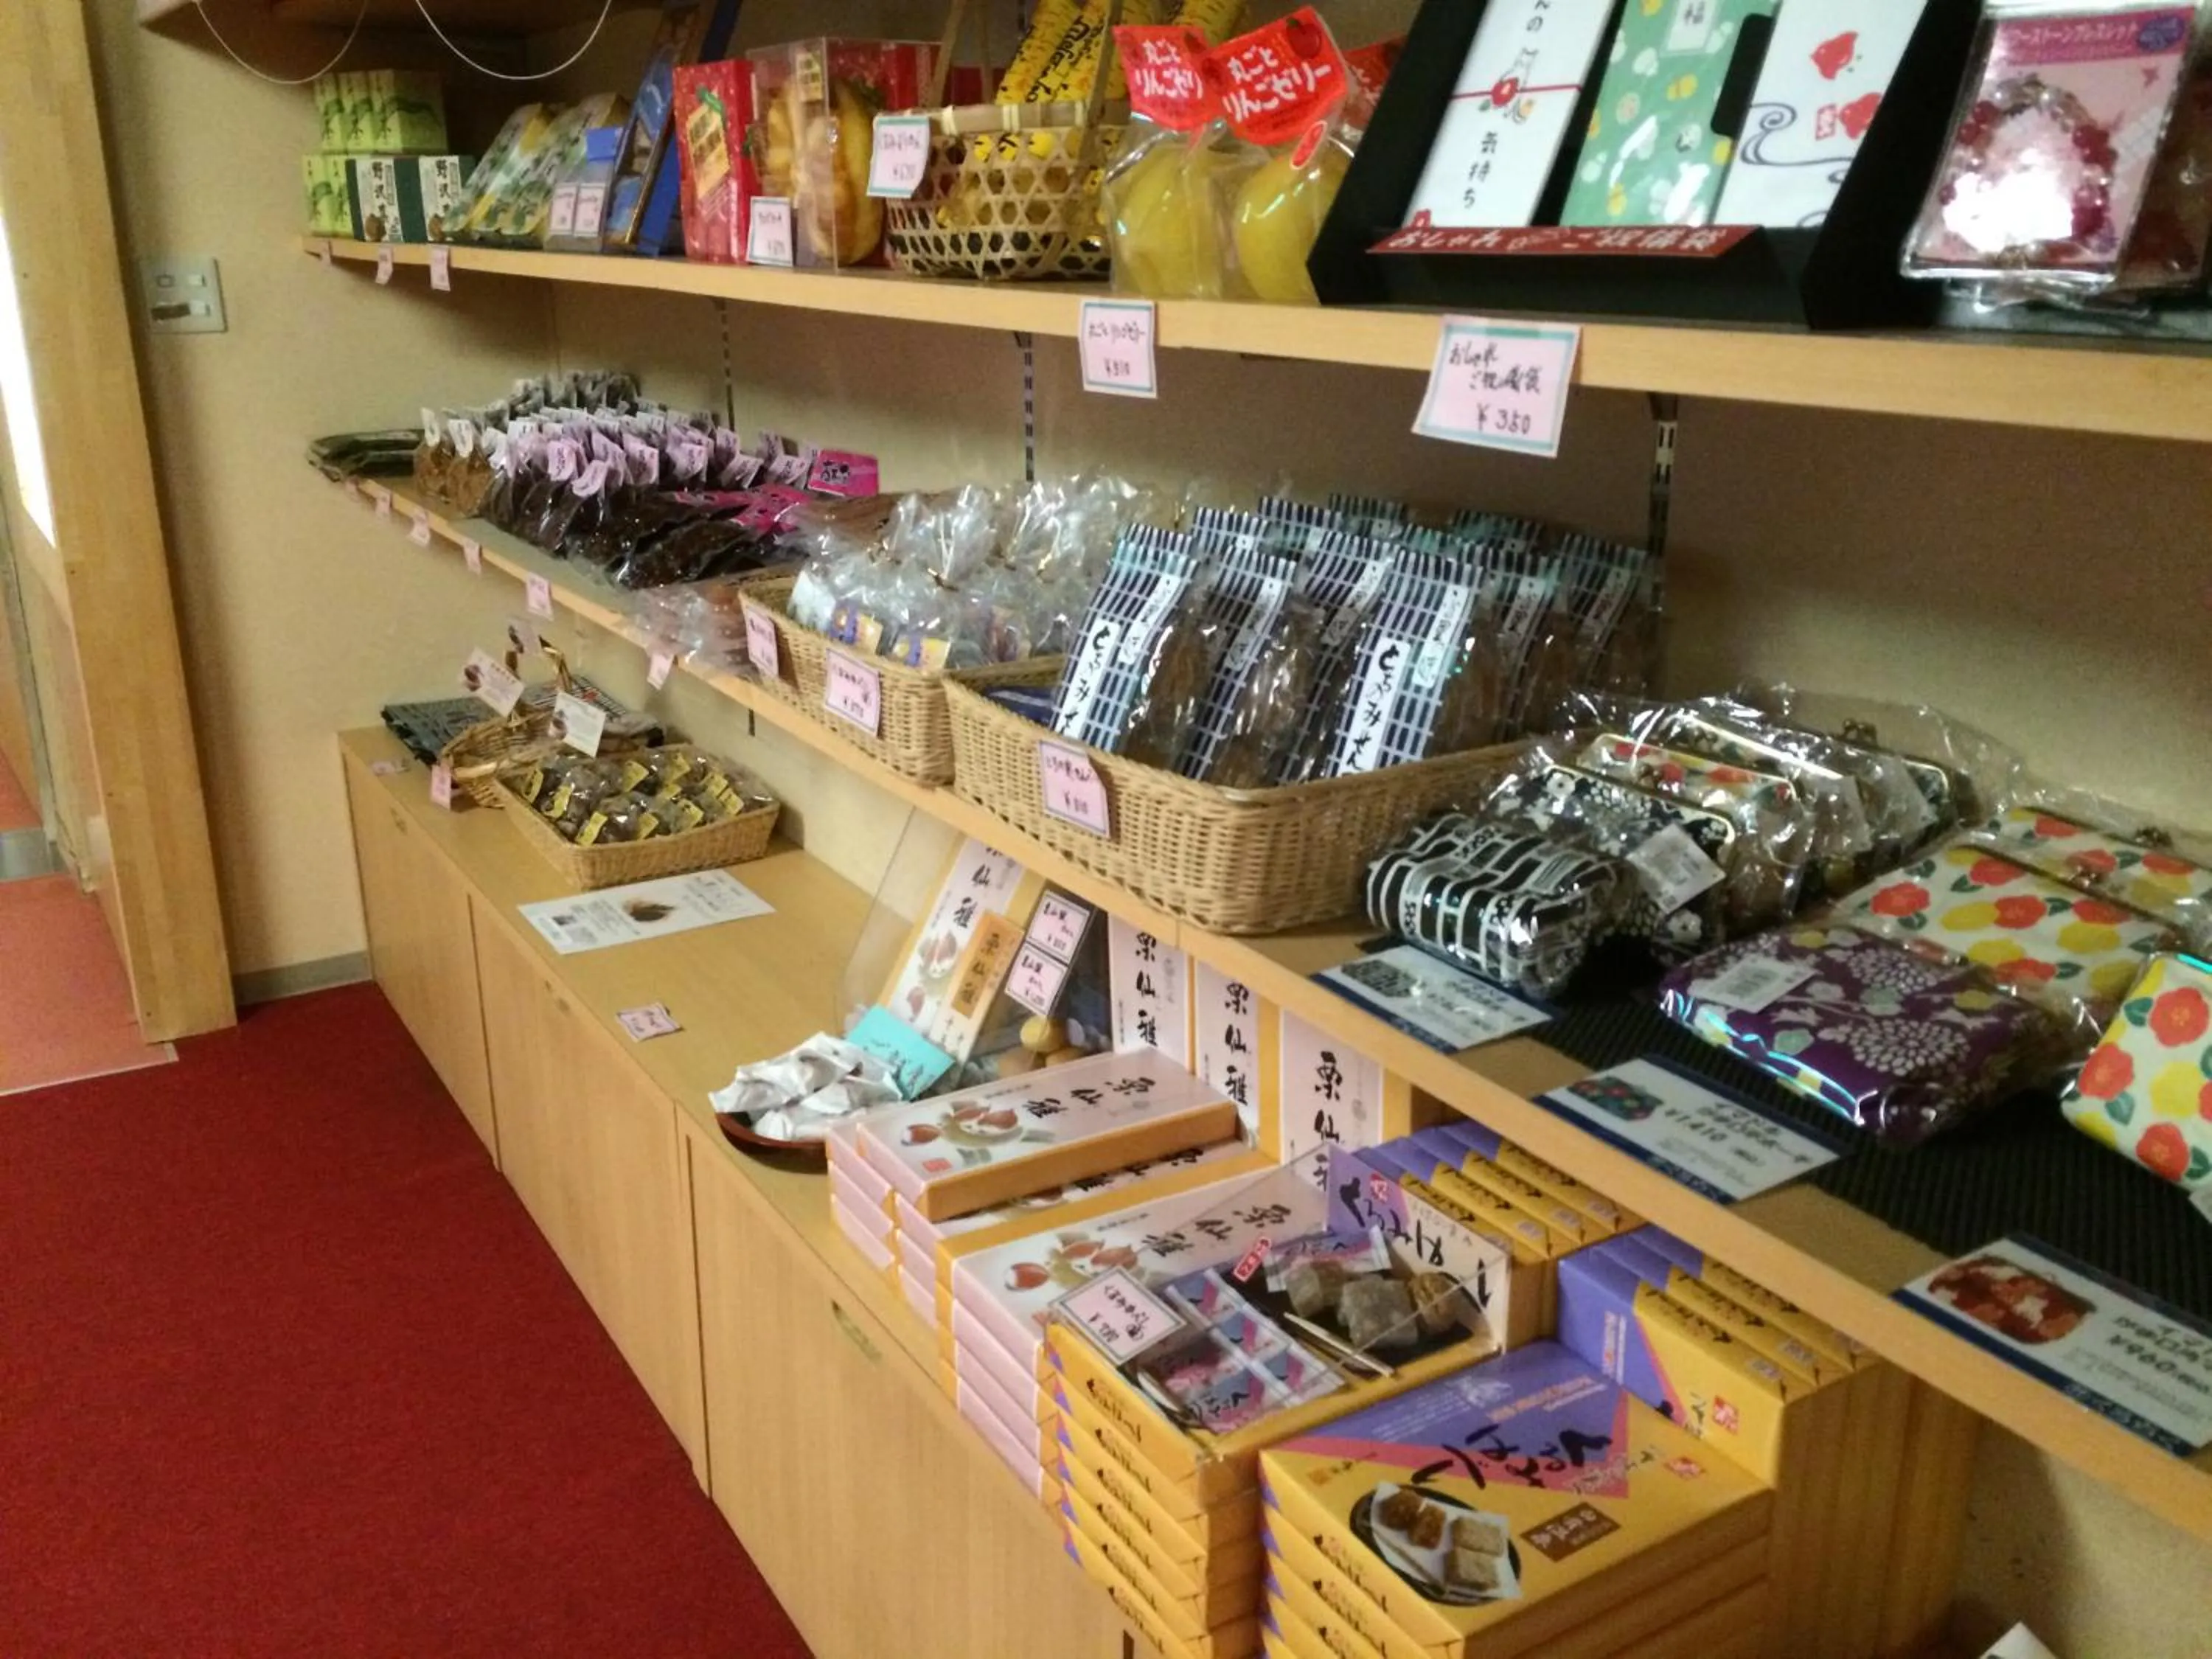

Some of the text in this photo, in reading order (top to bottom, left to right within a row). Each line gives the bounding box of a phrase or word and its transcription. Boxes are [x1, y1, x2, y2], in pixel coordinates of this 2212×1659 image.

[1228, 45, 1279, 84] 丸ごと
[1222, 62, 1332, 124] りんごゼリー
